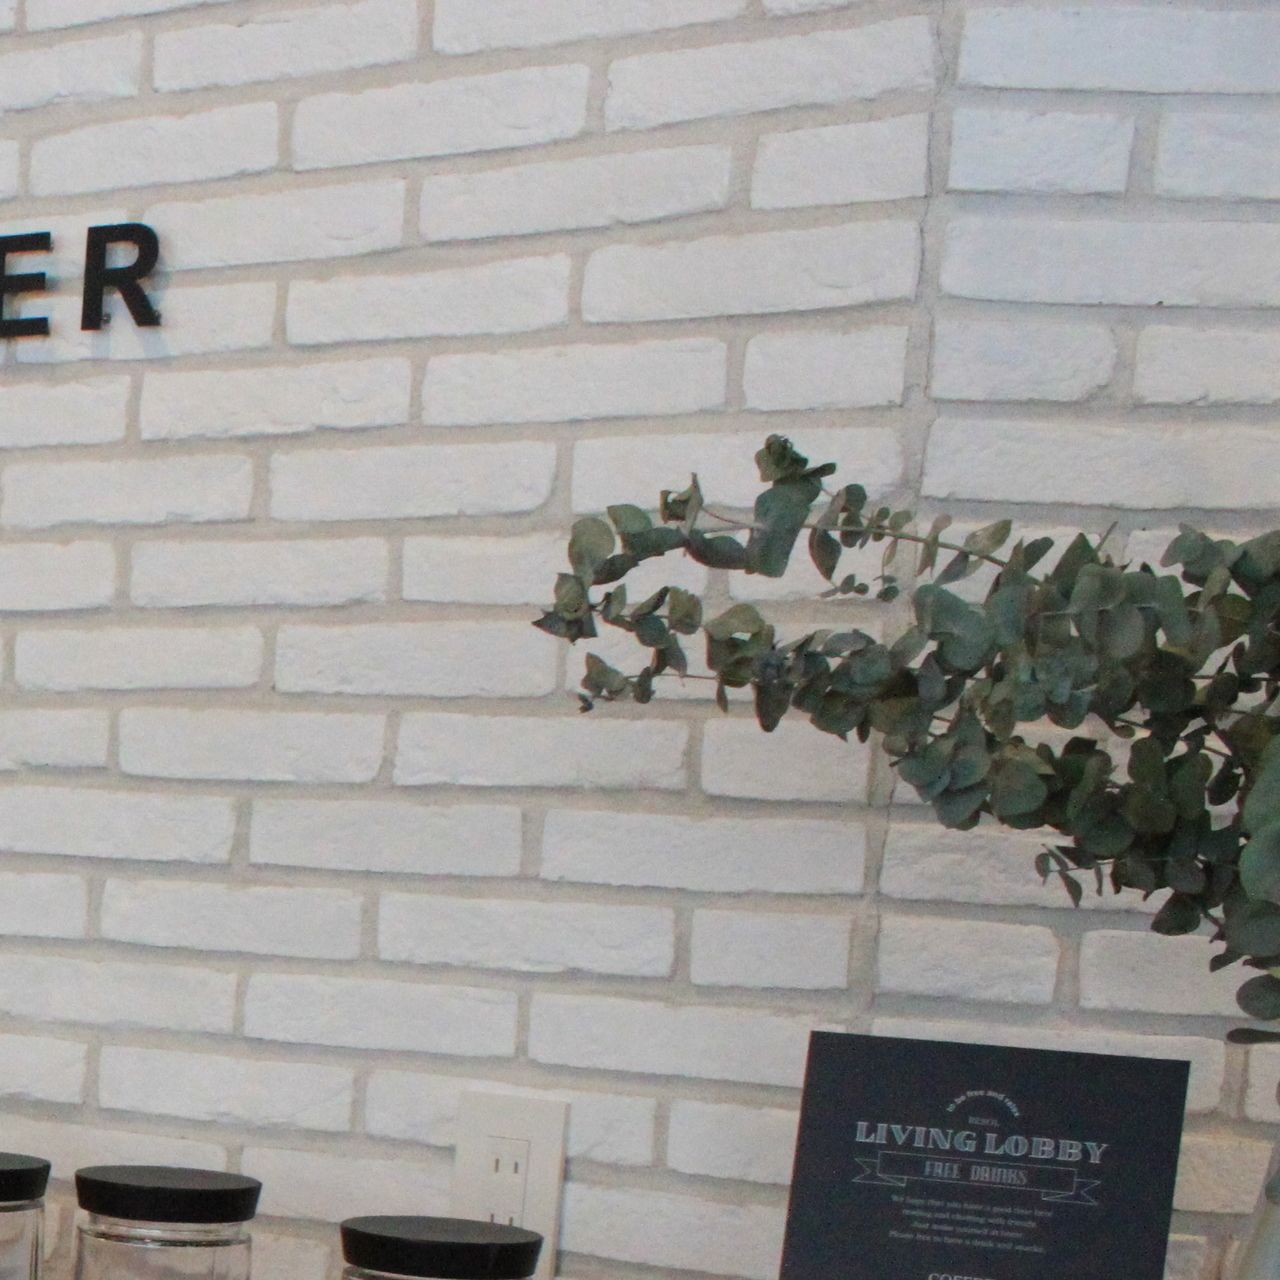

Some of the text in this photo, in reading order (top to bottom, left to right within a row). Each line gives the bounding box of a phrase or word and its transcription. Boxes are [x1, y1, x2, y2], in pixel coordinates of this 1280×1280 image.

[855, 1121, 1109, 1164] LIVING LOBBY
[924, 1160, 1028, 1185] FREE DRINKS
